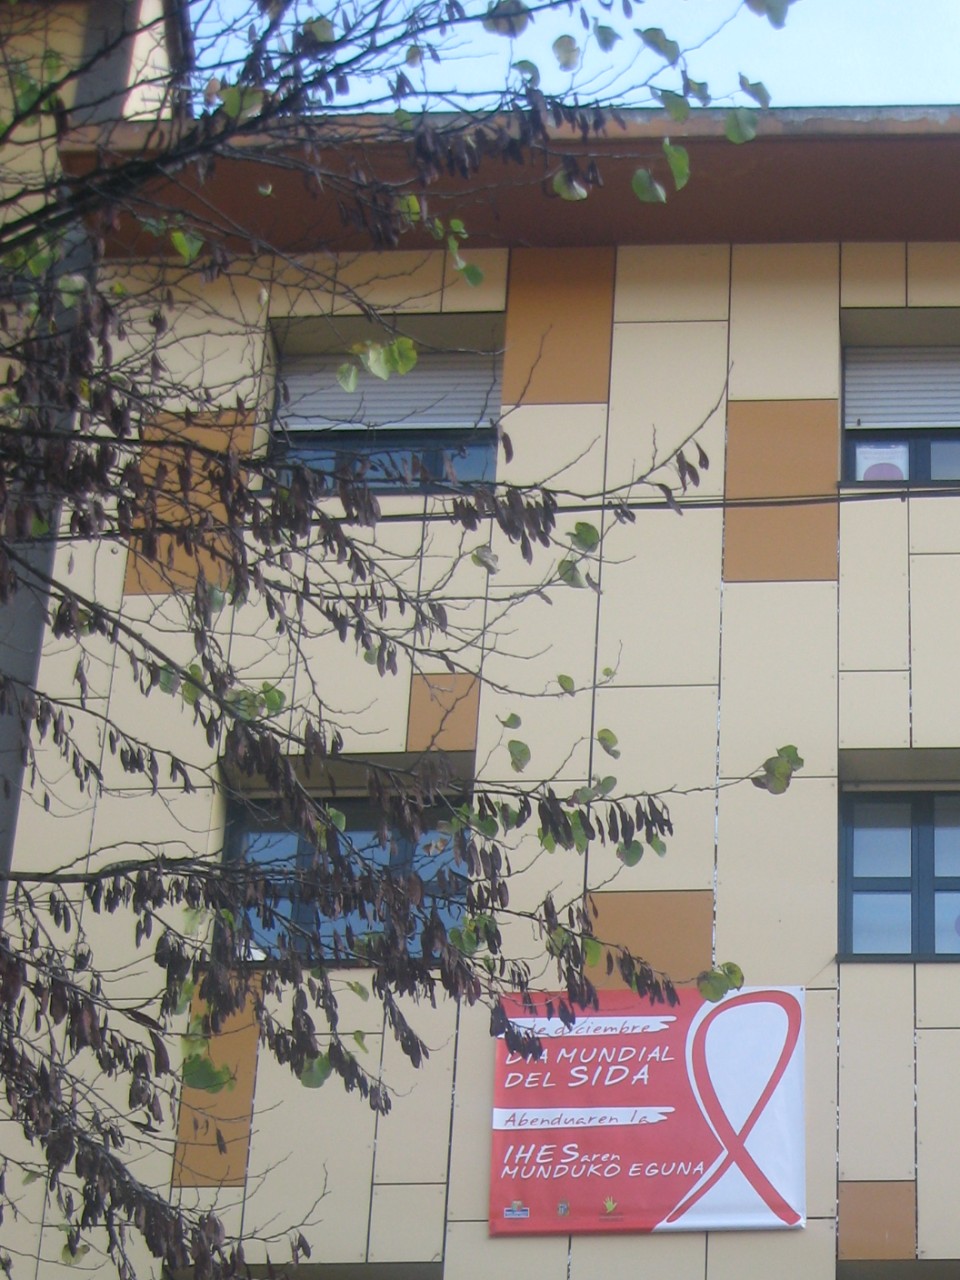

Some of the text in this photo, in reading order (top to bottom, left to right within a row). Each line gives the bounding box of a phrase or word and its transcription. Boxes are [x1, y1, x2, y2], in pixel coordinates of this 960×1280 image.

[554, 1019, 651, 1036] dciembre
[556, 1045, 676, 1064] MUNDIAL
[504, 1064, 650, 1088] DEL SIDA
[504, 1111, 619, 1127] Abenduaren
[503, 1143, 621, 1165] IHESaren
[500, 1161, 705, 1180] MUNDUKO EGUNA
